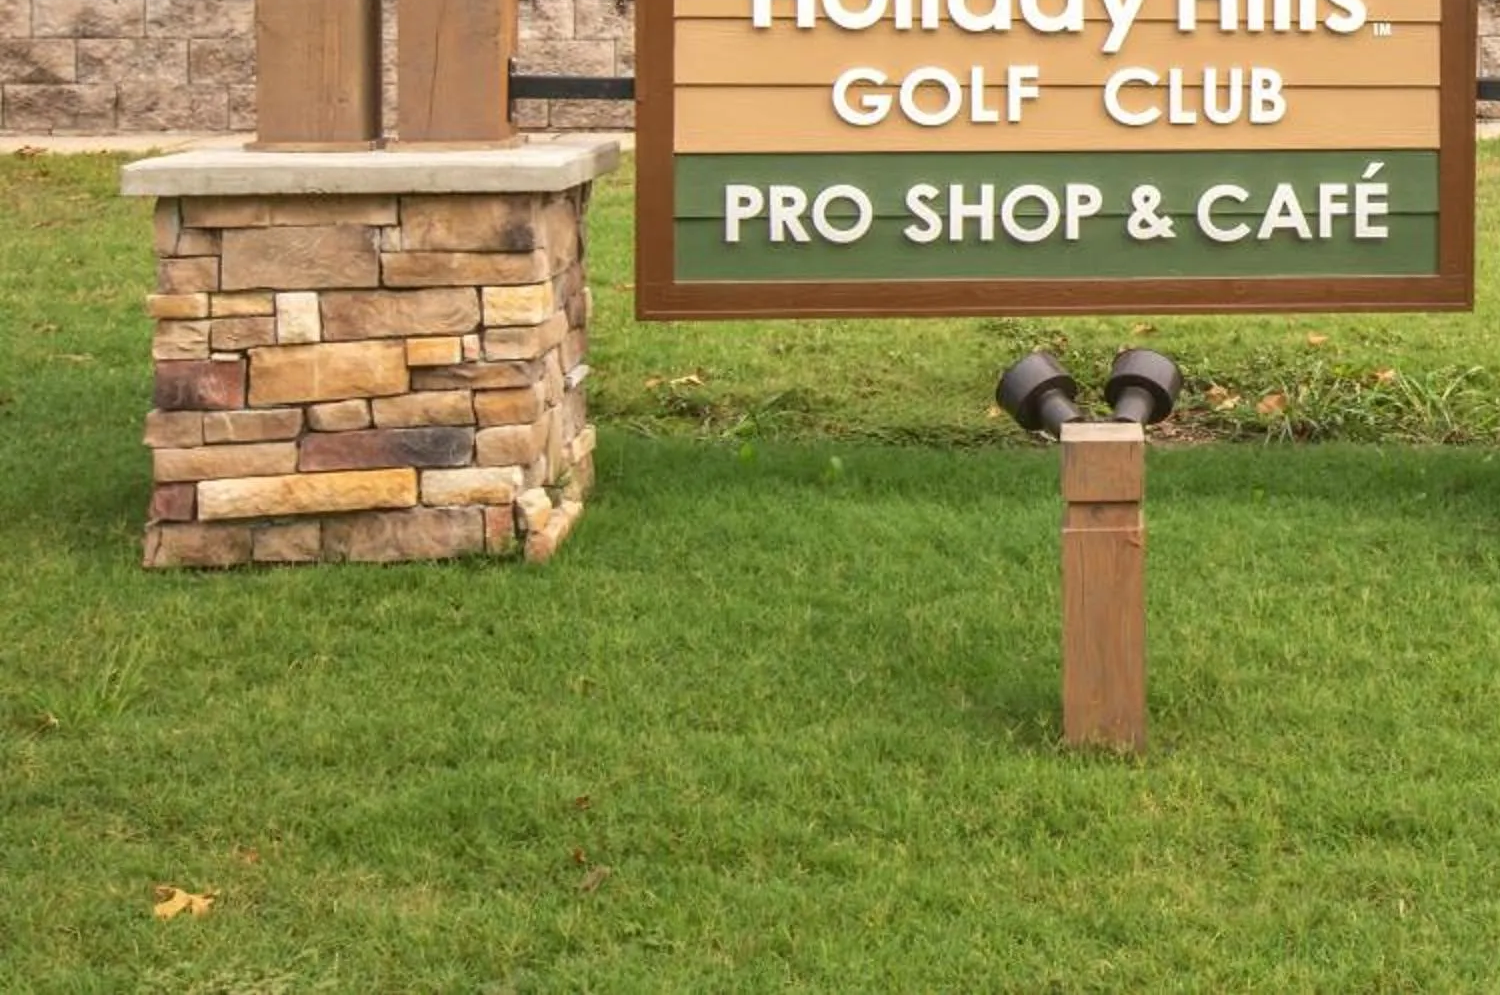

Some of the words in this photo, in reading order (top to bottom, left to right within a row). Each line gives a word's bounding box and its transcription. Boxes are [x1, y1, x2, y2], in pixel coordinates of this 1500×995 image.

[832, 64, 1040, 127] GOLF
[1103, 65, 1287, 126] CLUB
[724, 183, 873, 244] PRO
[903, 183, 1104, 243] SHOP
[1126, 183, 1176, 240] &
[1196, 162, 1389, 242] CAFÉ
